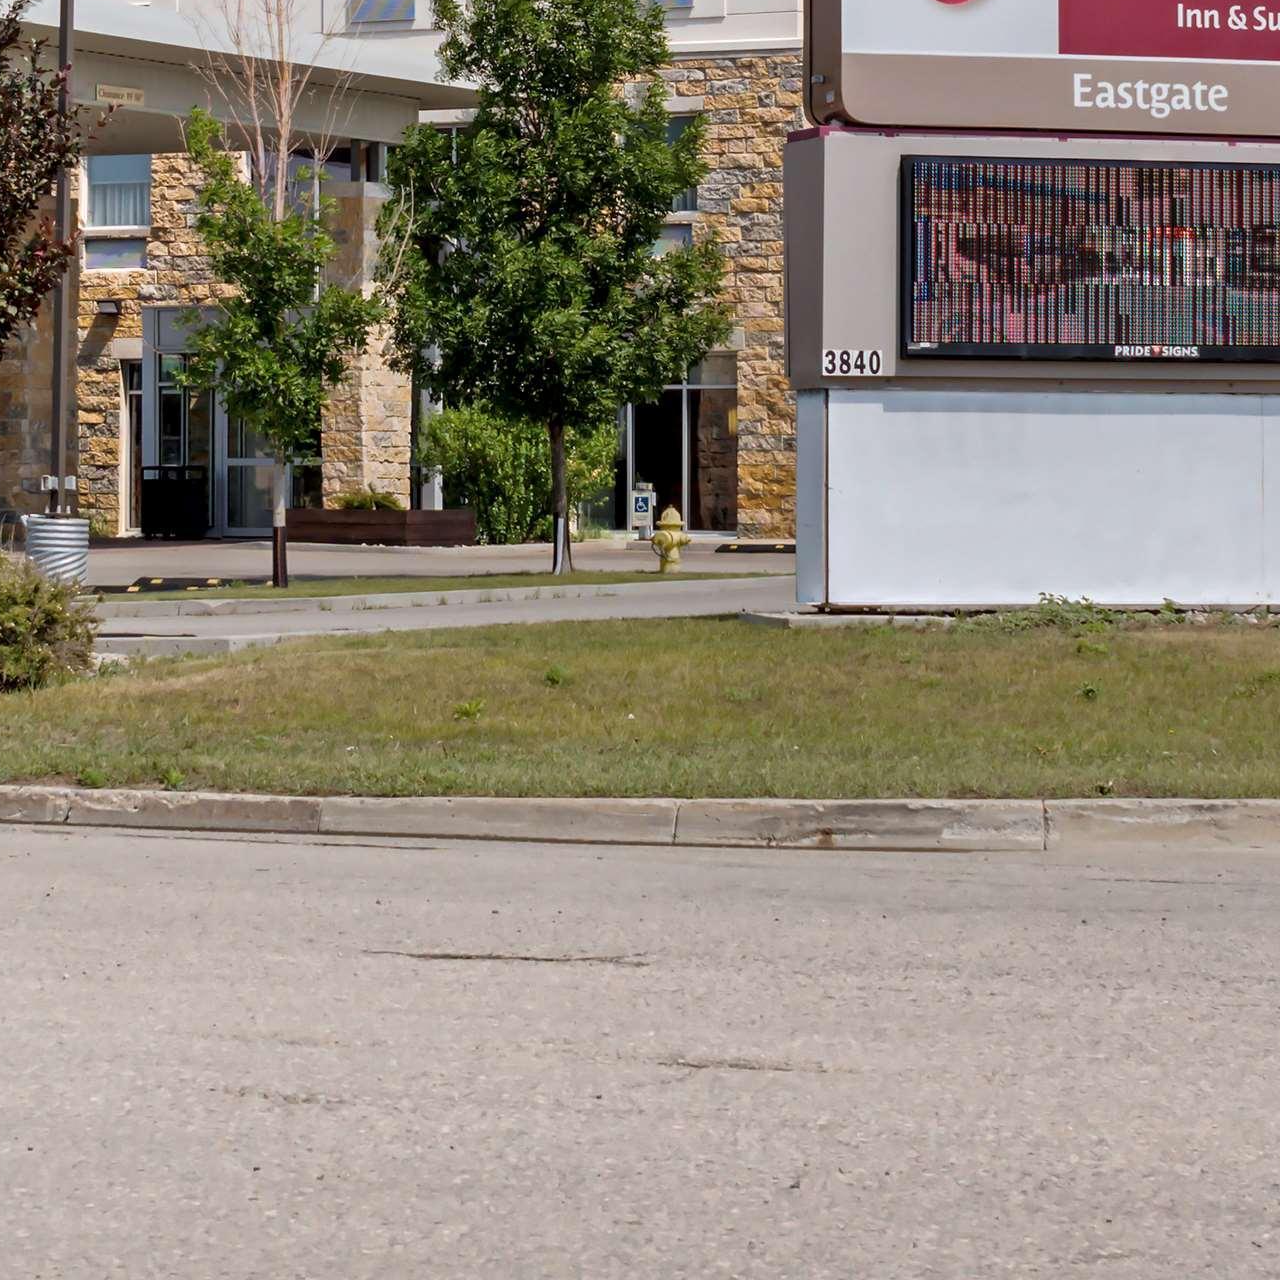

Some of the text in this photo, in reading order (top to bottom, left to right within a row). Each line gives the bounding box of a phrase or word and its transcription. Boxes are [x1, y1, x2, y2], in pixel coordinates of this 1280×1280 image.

[1177, 3, 1221, 30] Inn
[1227, 5, 1249, 31] &
[1073, 72, 1229, 119] Eastgate
[823, 350, 881, 376] 3840
[1114, 345, 1200, 358] PRIDE SIGNS
